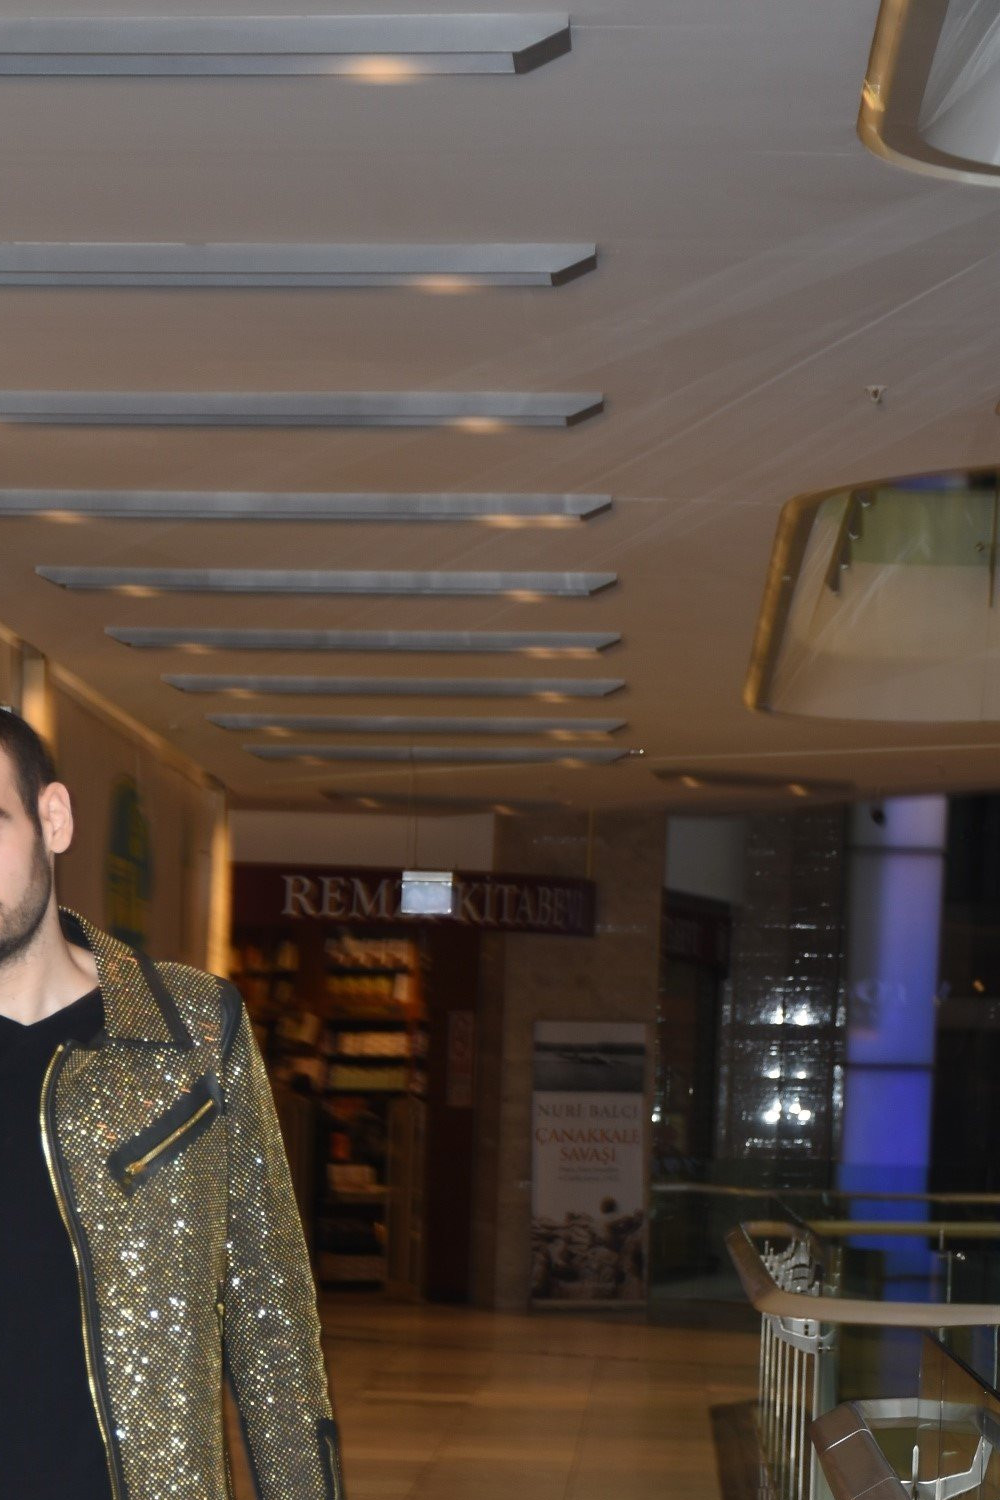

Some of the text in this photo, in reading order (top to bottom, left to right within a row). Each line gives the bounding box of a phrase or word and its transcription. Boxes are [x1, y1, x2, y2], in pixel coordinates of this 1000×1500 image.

[281, 874, 441, 920] REM
[535, 1127, 640, 1146] ÇANAKKALE
[560, 1146, 616, 1165] SAVAŞI
